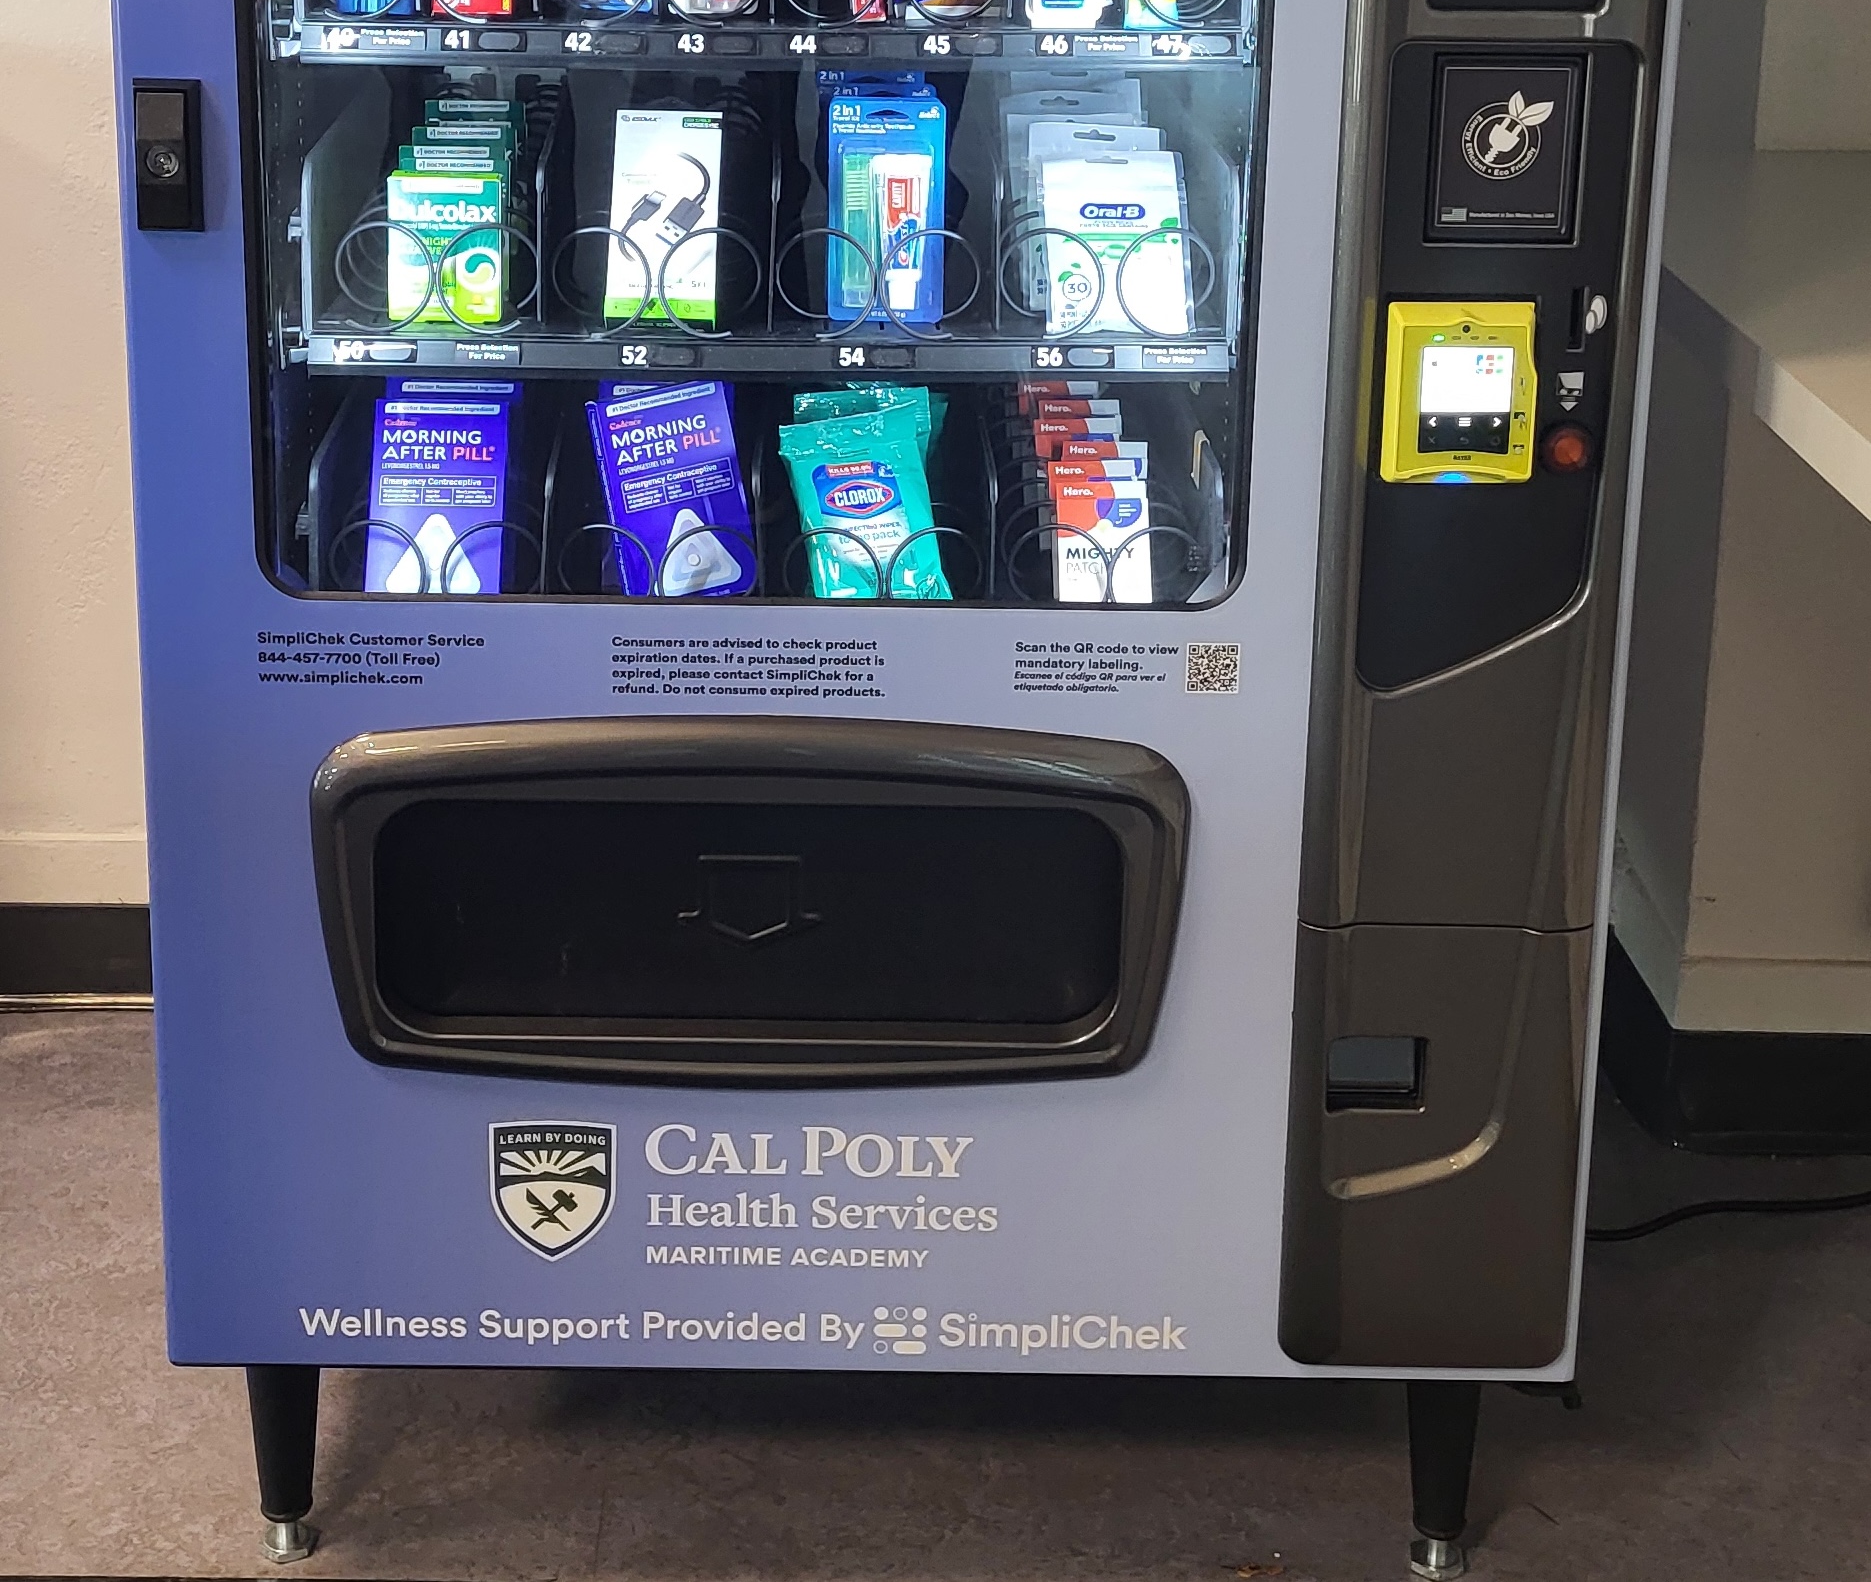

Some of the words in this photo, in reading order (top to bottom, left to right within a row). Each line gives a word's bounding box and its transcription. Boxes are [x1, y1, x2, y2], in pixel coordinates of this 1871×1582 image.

[445, 30, 470, 49] 41
[564, 32, 592, 51] 42
[678, 34, 704, 53] 43
[790, 35, 816, 53] 44
[924, 35, 950, 53] 45
[1041, 35, 1068, 54] 46
[1464, 115, 1483, 141] Energy
[1466, 143, 1487, 173] Efficient
[1511, 147, 1537, 173] Friendly
[390, 200, 496, 222] ulcolax
[1084, 206, 1140, 218] Oral-B
[1067, 282, 1088, 294] 30
[621, 346, 647, 364] 52
[838, 348, 865, 366] 54
[1037, 348, 1063, 367] 56
[382, 430, 481, 444] MORNING
[611, 414, 706, 449] MORNING
[382, 446, 447, 460] AFTER
[453, 446, 493, 461] PILL
[616, 439, 678, 466] AFTER
[682, 430, 721, 451] PILL
[834, 487, 886, 507] CLOROX
[257, 632, 345, 648] SimpliChek
[350, 633, 424, 646] Customer
[427, 634, 485, 647] Service
[612, 637, 685, 648] Consumers
[688, 639, 709, 648] are
[712, 638, 763, 650] advised
[766, 639, 780, 650] to
[782, 639, 822, 650] check
[826, 640, 878, 652] product
[1015, 642, 1047, 653] Scan
[1050, 643, 1071, 653] the
[1074, 643, 1094, 654] QR
[1097, 643, 1128, 654] code
[1132, 644, 1145, 655] to
[1149, 644, 1179, 655] view
[258, 652, 362, 664] 844-457-7700
[365, 651, 399, 667] (Toll
[402, 652, 441, 668] Free)
[612, 652, 678, 665] expiration
[682, 654, 721, 664] dates.
[724, 654, 734, 664] If
[736, 656, 744, 664] a
[748, 654, 816, 667] purchased
[819, 656, 872, 668] product
[874, 656, 885, 666] is
[1015, 658, 1085, 671] mandatory
[1088, 659, 1144, 672] labeling.
[259, 671, 424, 686] www.simplichek.com
[612, 668, 666, 680] expired,
[668, 669, 710, 680] please
[714, 670, 764, 680] contact
[766, 670, 842, 682] SimpliChek
[845, 671, 863, 682] for
[866, 673, 874, 682] a
[1055, 672, 1064, 680] el
[1065, 672, 1097, 682] código
[1099, 673, 1113, 682] QR
[1115, 674, 1138, 683] para
[1157, 674, 1167, 682] el
[612, 684, 660, 694] refund.
[662, 684, 680, 694] Do
[684, 685, 706, 695] not
[708, 686, 767, 696] consume
[770, 686, 819, 698] expired
[822, 686, 886, 698] products.
[1013, 683, 1064, 693] etiquetado
[1065, 683, 1119, 693] obligatorio.
[499, 1133, 542, 1145] LEARN
[545, 1133, 562, 1144] BY
[564, 1133, 606, 1146] DOING
[645, 1122, 787, 1176] CAL
[801, 1125, 974, 1178] POLY
[646, 1192, 799, 1228] Health
[811, 1194, 998, 1232] Services
[645, 1245, 782, 1266] MARITIME
[790, 1247, 930, 1268] ACADEMY
[299, 1307, 467, 1337] Wellness
[479, 1309, 630, 1346] Support
[641, 1310, 806, 1343] Provided
[820, 1313, 864, 1349] By
[939, 1312, 1188, 1356] SimpliChek
